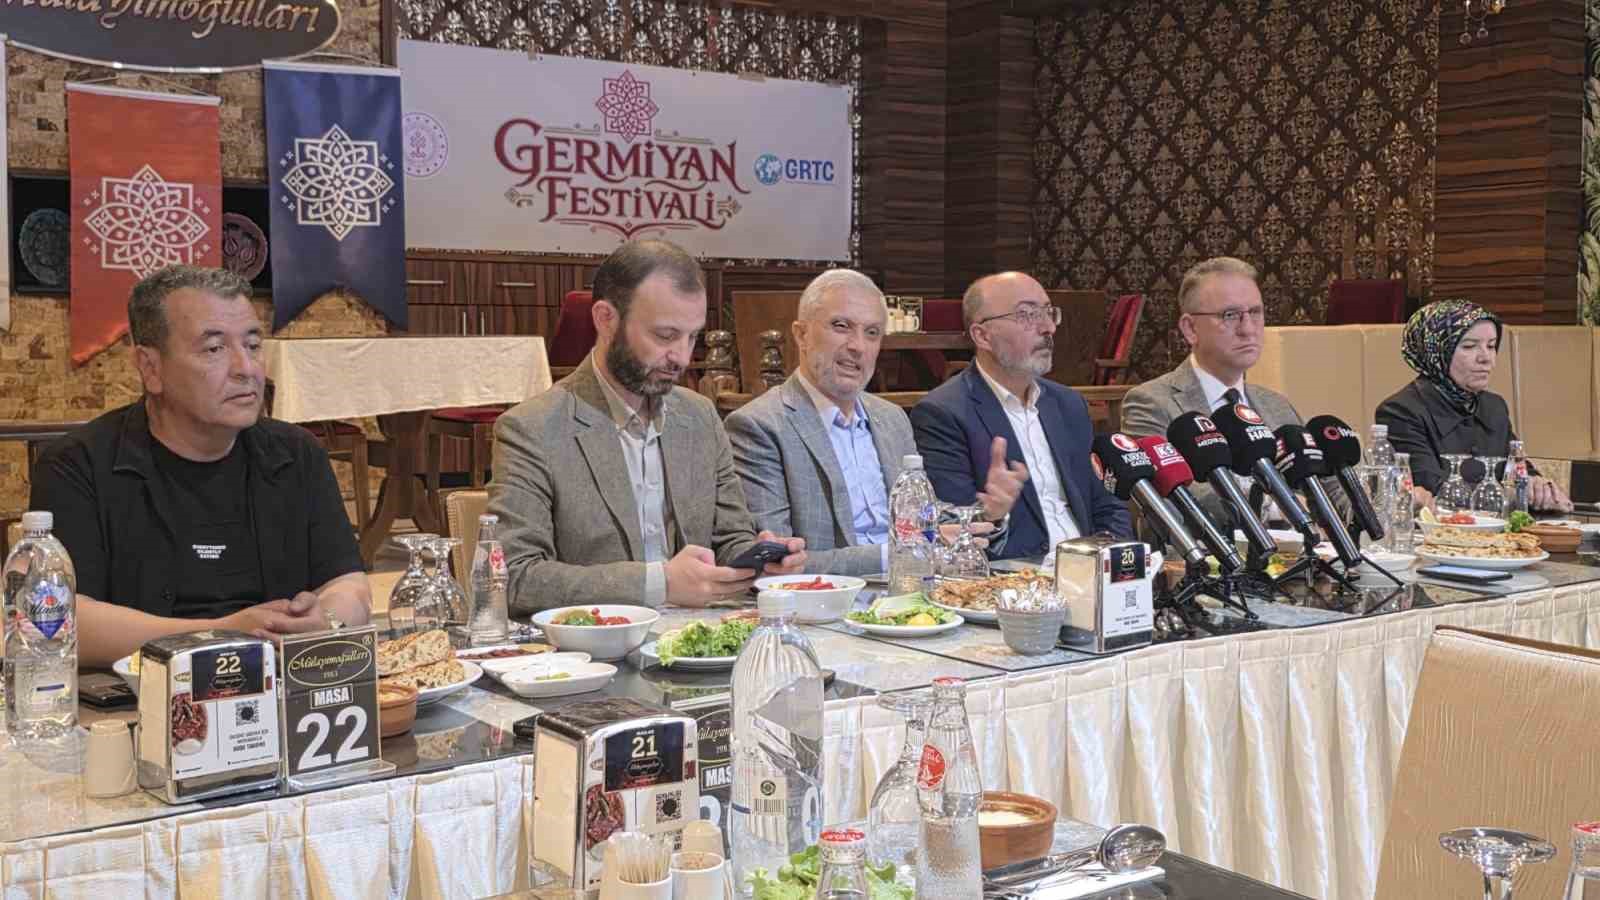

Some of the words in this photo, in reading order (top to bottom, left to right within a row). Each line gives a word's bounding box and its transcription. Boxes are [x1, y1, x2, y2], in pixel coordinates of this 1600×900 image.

[785, 158, 834, 182] GRTC
[1121, 551, 1135, 564] 20
[215, 656, 242, 675] 22
[313, 686, 350, 707] MASA
[296, 705, 369, 771] 22
[631, 735, 658, 758] 21
[704, 765, 734, 788] MAS
